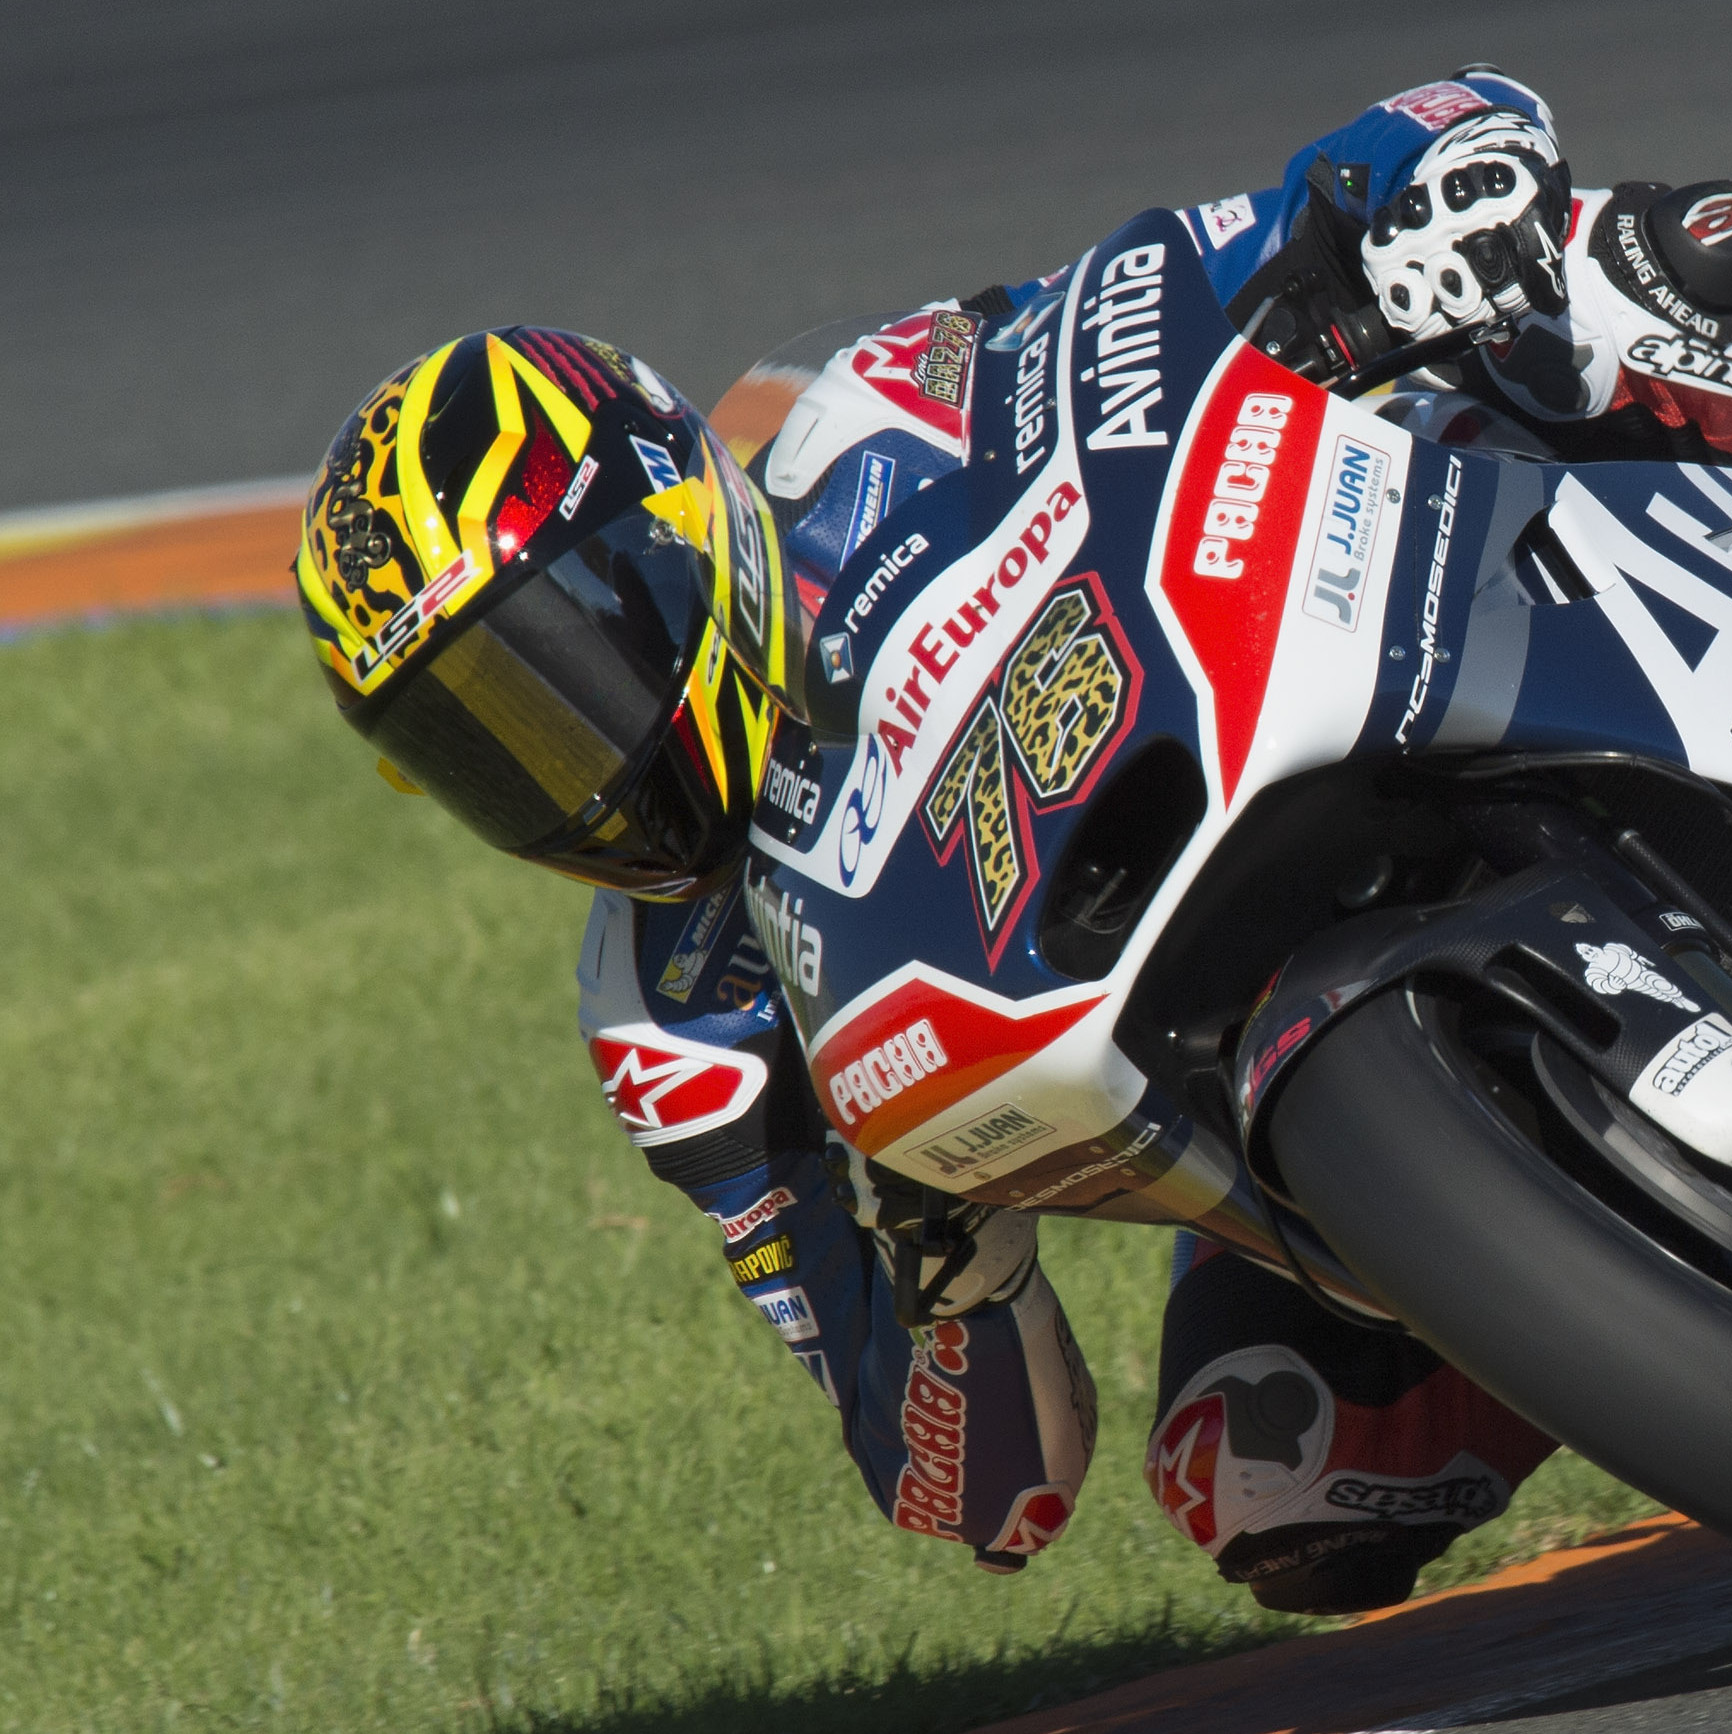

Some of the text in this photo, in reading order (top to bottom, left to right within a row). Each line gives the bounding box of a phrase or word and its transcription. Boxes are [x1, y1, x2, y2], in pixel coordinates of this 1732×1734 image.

[1617, 214, 1719, 339] RACING AHEAD
[1005, 331, 1050, 475] remica
[1081, 242, 1169, 451] Avintia
[855, 457, 884, 551] ICHELIN
[1193, 393, 1293, 579] PACHA
[1354, 458, 1384, 561] Brake systems
[353, 548, 483, 687] LS2
[844, 532, 931, 634] remica
[764, 759, 822, 825] remica
[920, 580, 1134, 955] 76
[829, 1018, 948, 1126] PACHA
[722, 1190, 790, 1238] uropa
